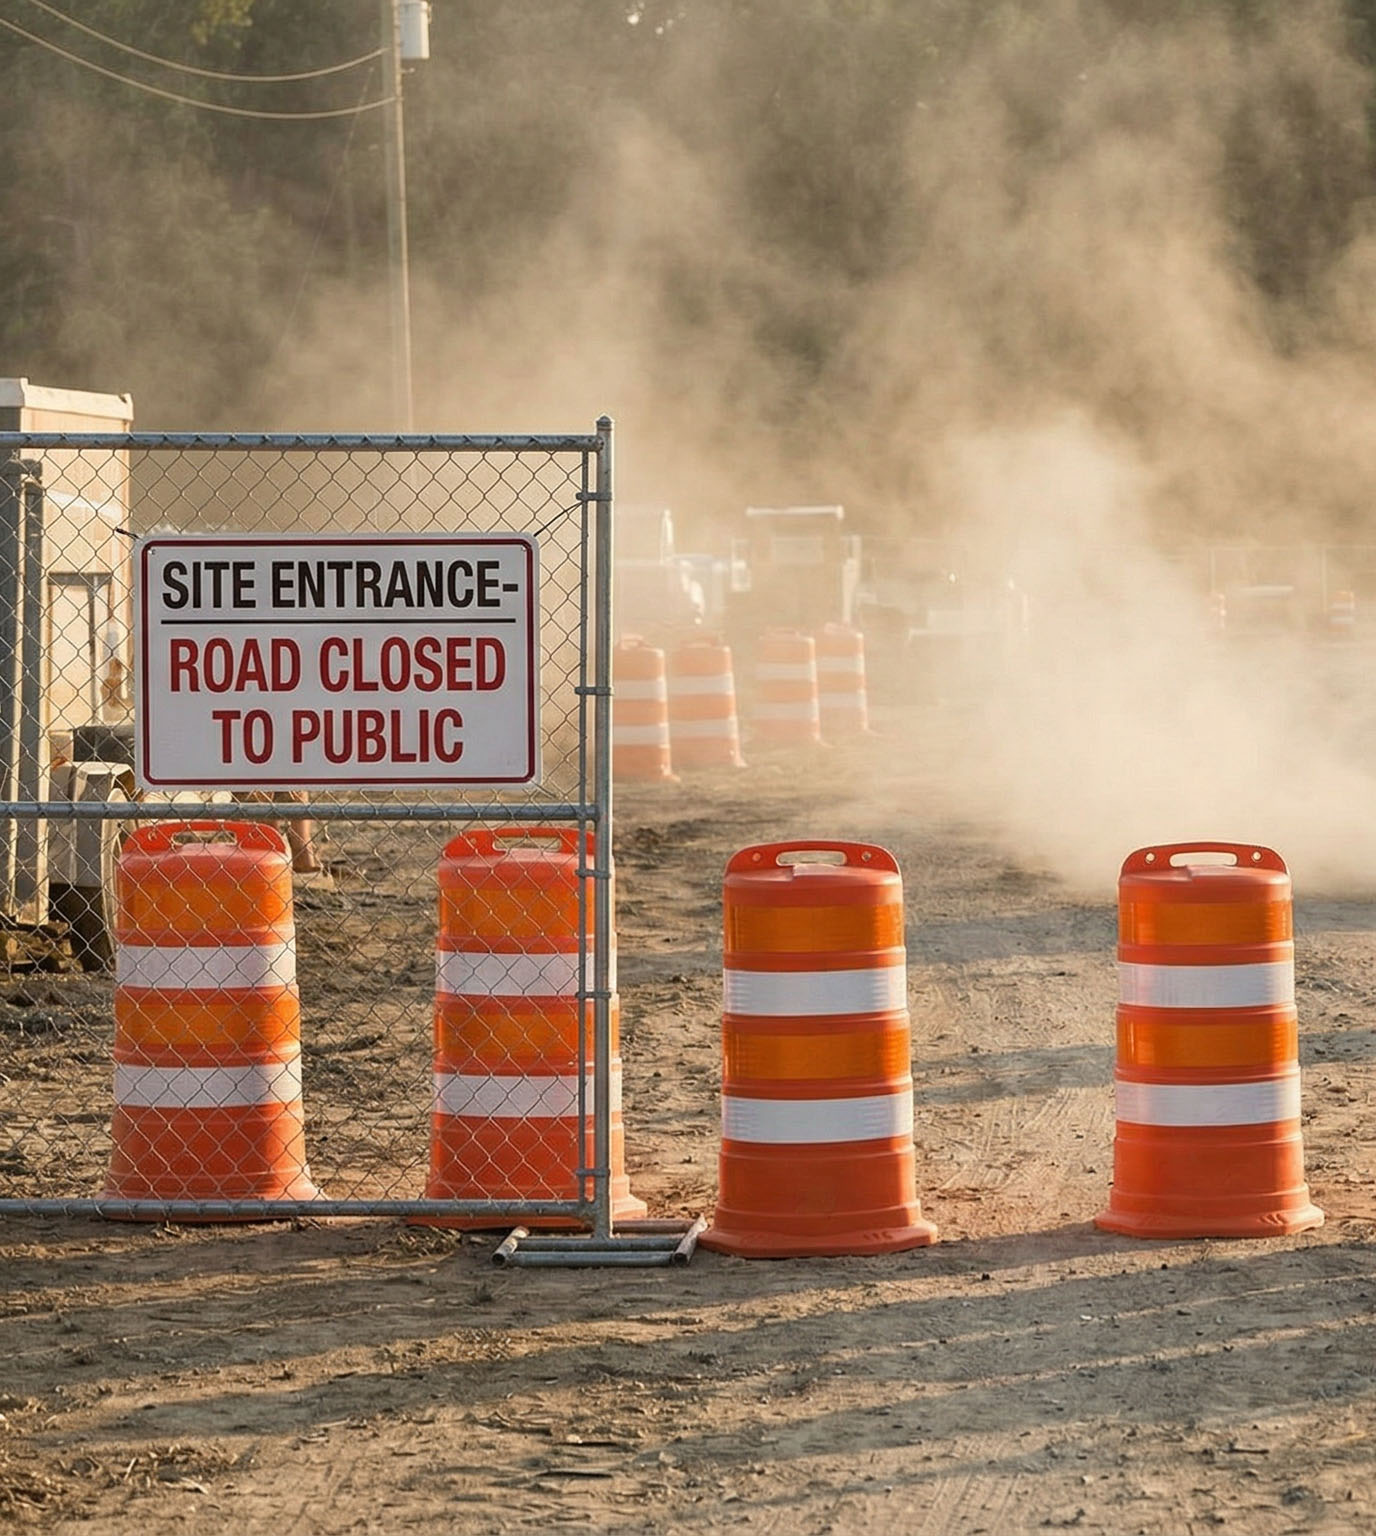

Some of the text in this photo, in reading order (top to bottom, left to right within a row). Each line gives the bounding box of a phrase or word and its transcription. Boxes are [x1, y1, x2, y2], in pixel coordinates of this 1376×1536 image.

[163, 560, 518, 609] SITE ENTRANCE-
[170, 637, 505, 693] ROAD CLOSED
[212, 709, 463, 764] TO PUBLIC
